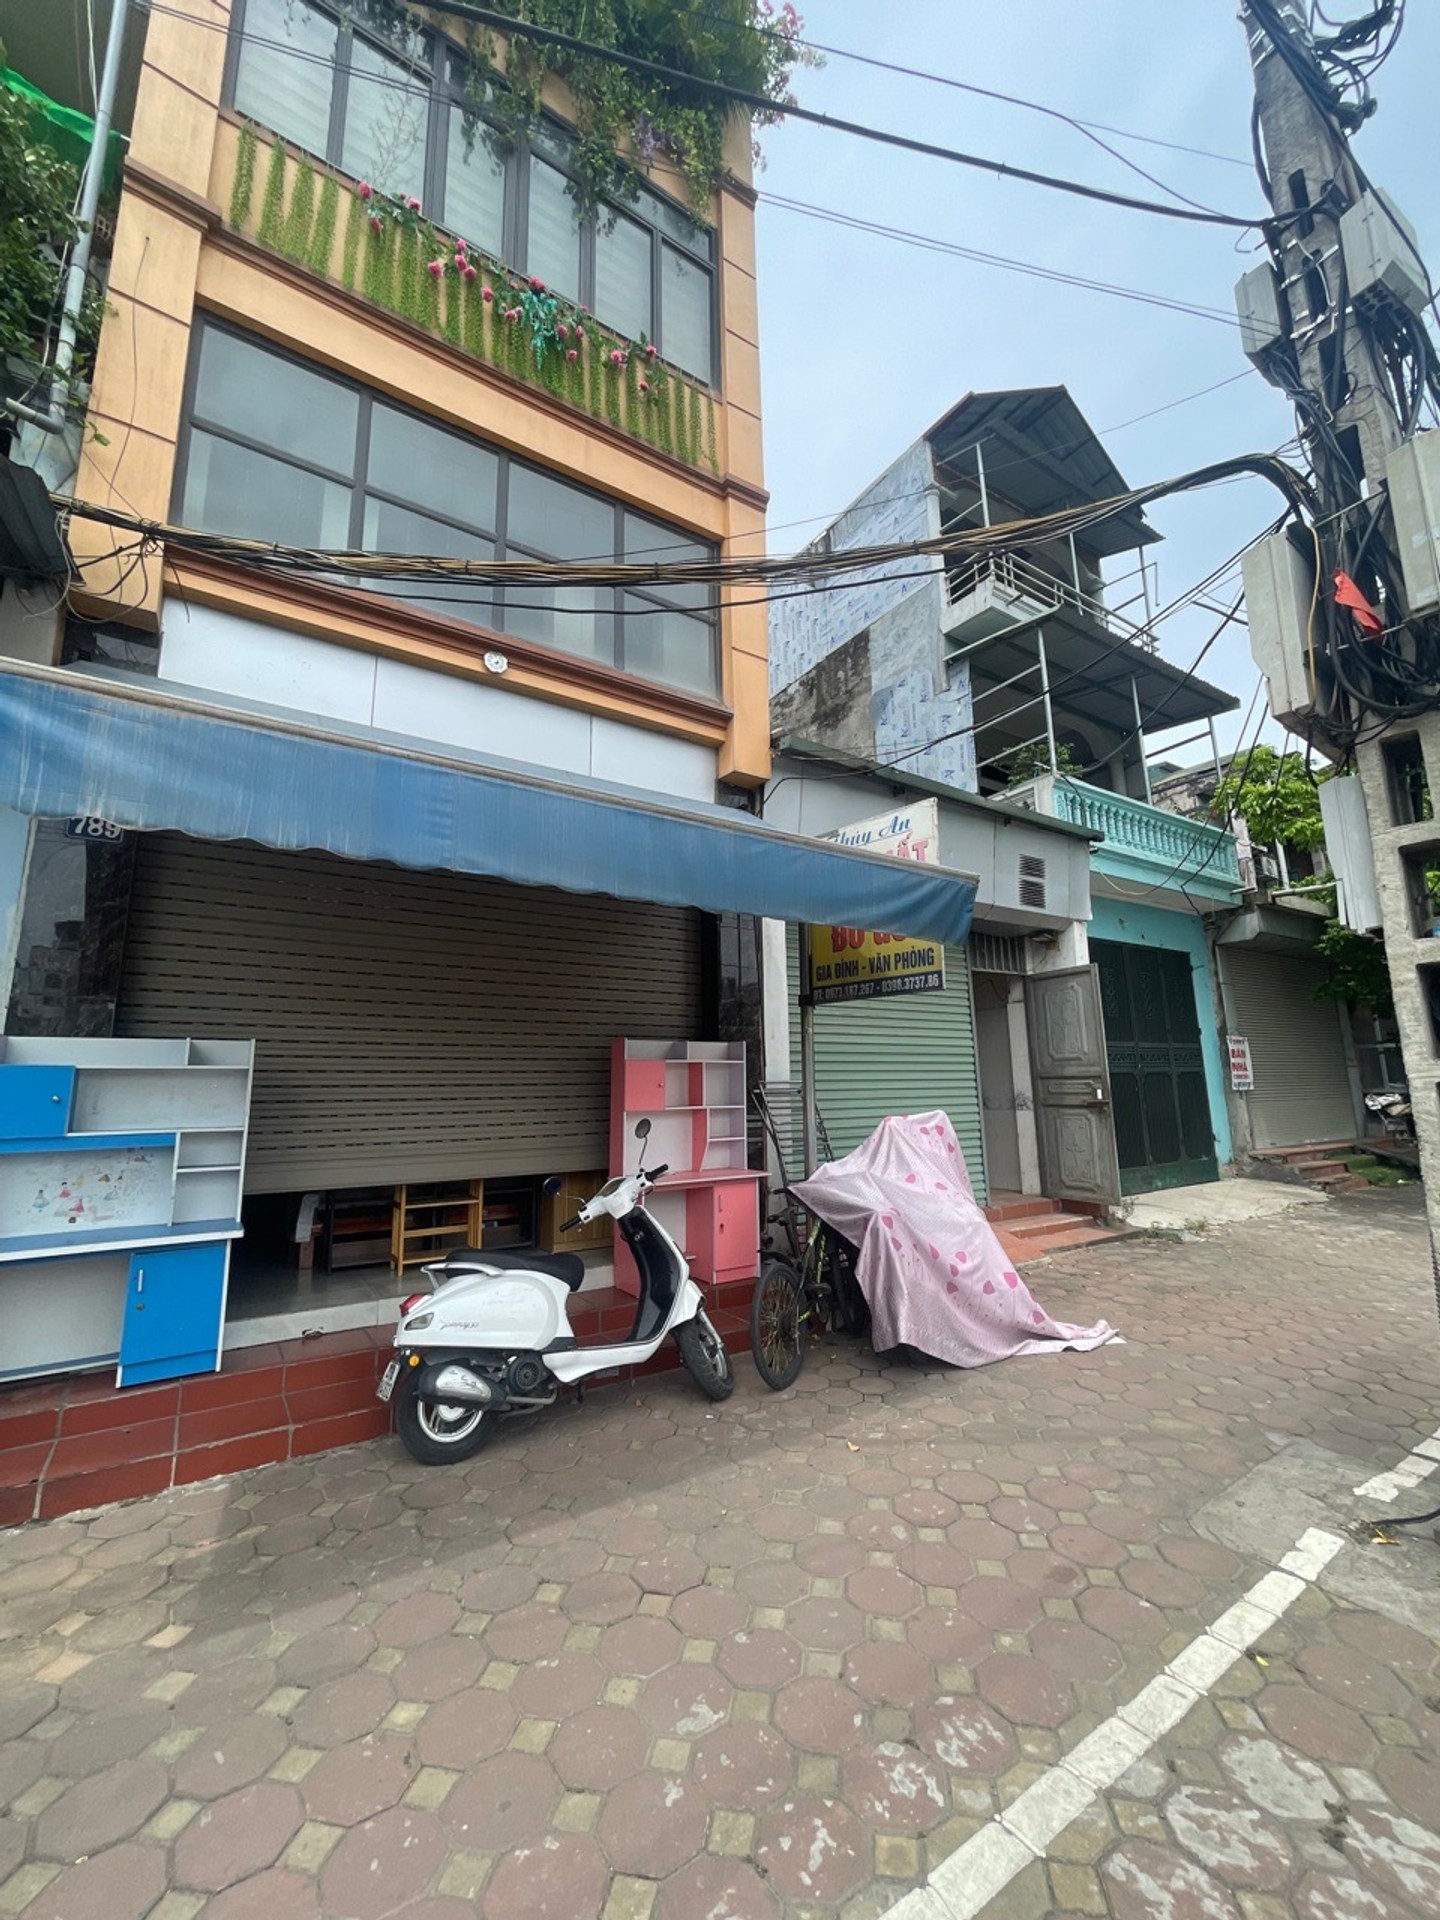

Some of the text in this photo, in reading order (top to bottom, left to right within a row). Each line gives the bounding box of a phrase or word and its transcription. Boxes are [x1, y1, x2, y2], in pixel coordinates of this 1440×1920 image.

[70, 816, 121, 838] 789
[879, 815, 911, 838] An
[816, 964, 832, 981] GIA
[834, 958, 859, 979] ĐÌNH
[868, 952, 891, 975] VĂN
[894, 945, 935, 970] PHÒNG
